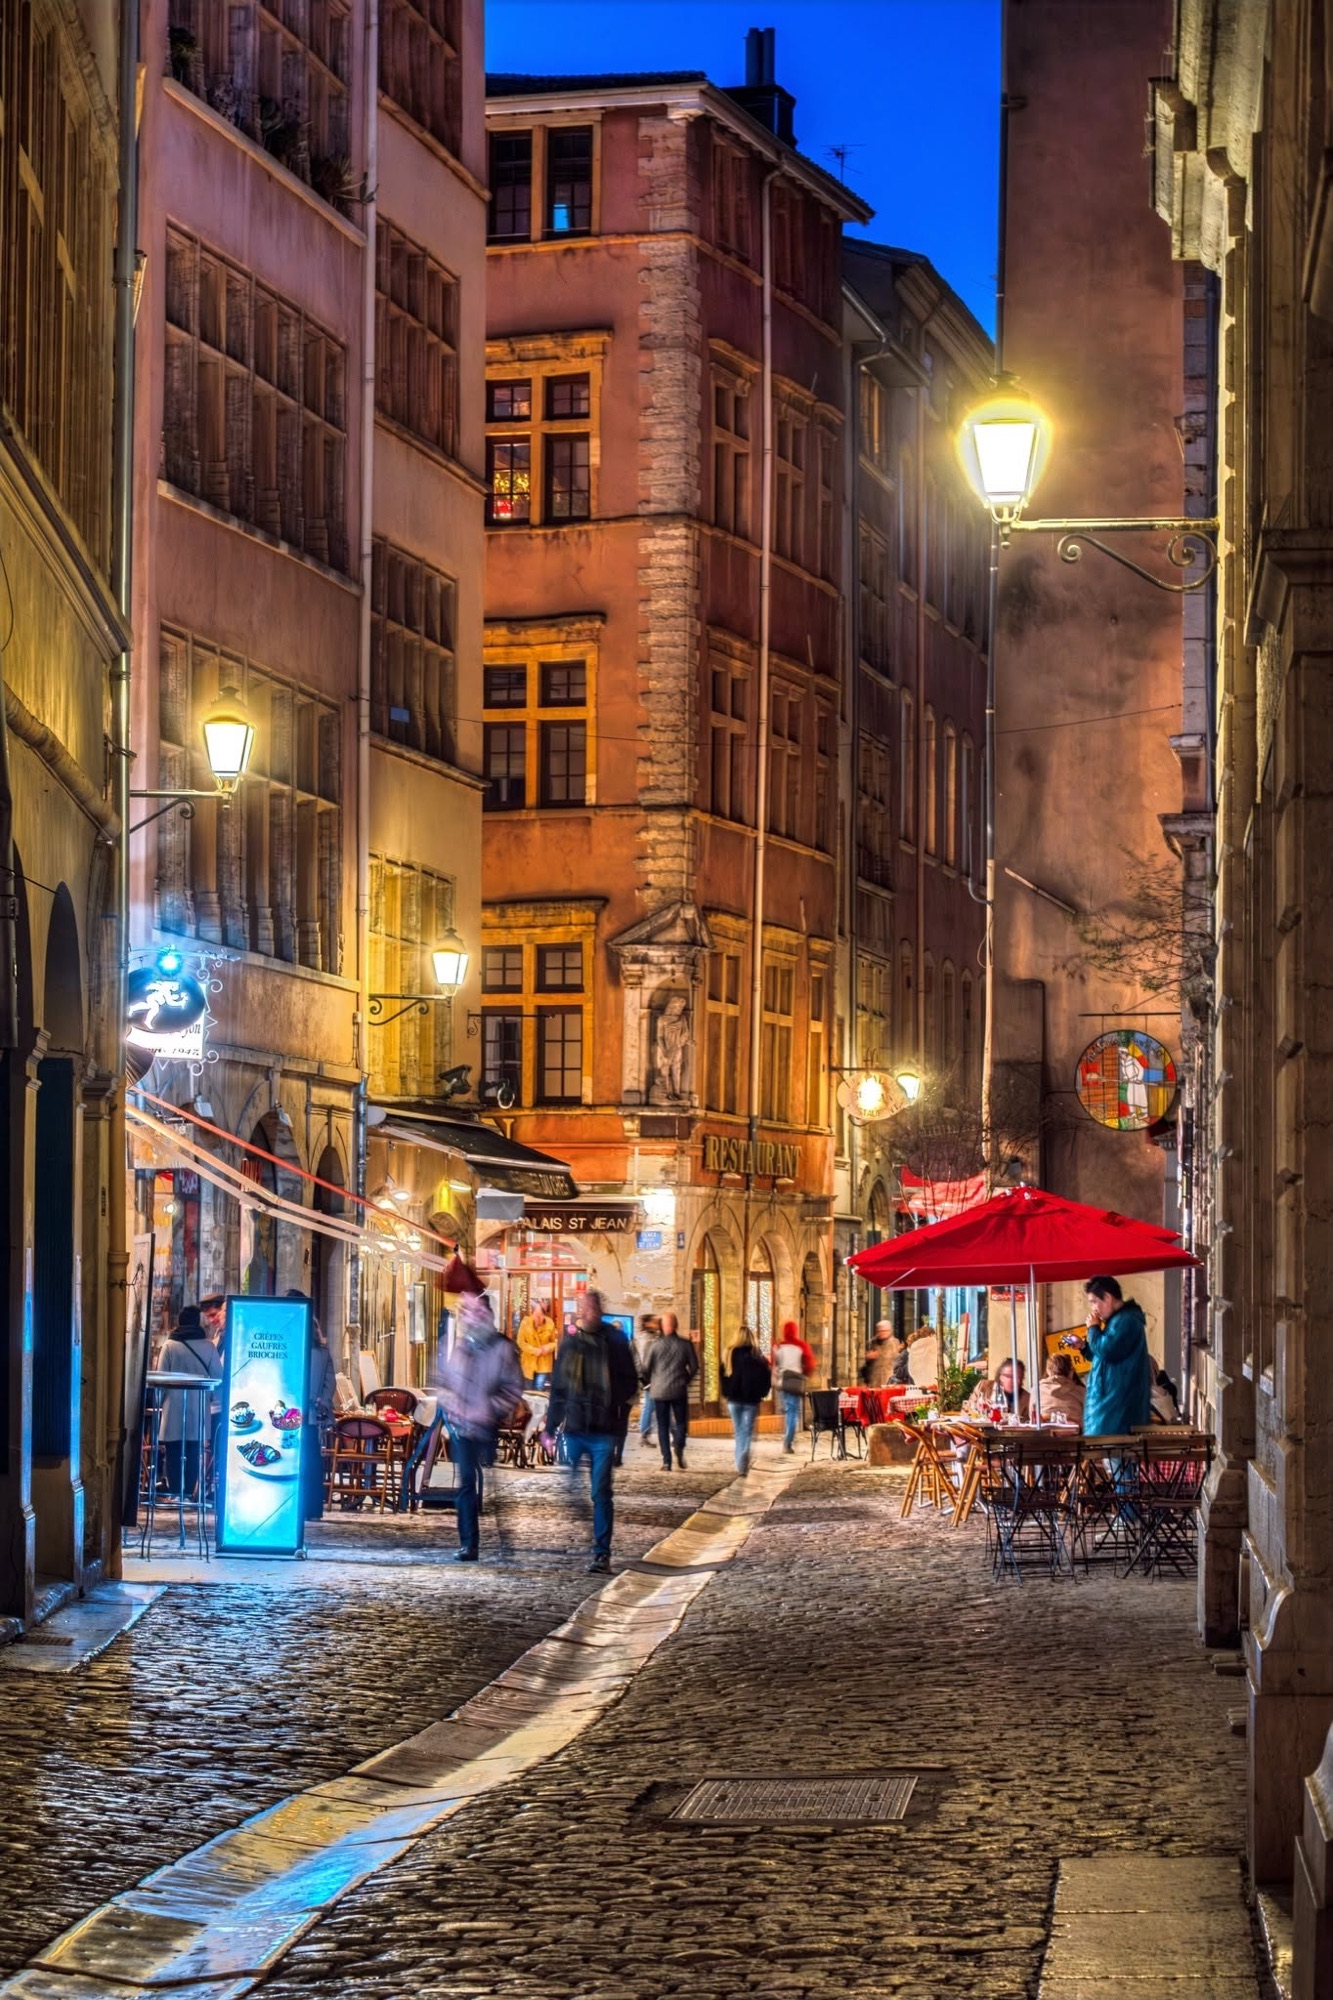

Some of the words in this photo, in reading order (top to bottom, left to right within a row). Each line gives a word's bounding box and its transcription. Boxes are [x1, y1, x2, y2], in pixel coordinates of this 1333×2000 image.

[705, 1135, 803, 1178] RESTAURANT
[568, 1217, 587, 1230] ST
[590, 1217, 627, 1231] JEAN
[251, 1341, 287, 1351] GAUFRES
[248, 1350, 288, 1359] BRIOCHES
